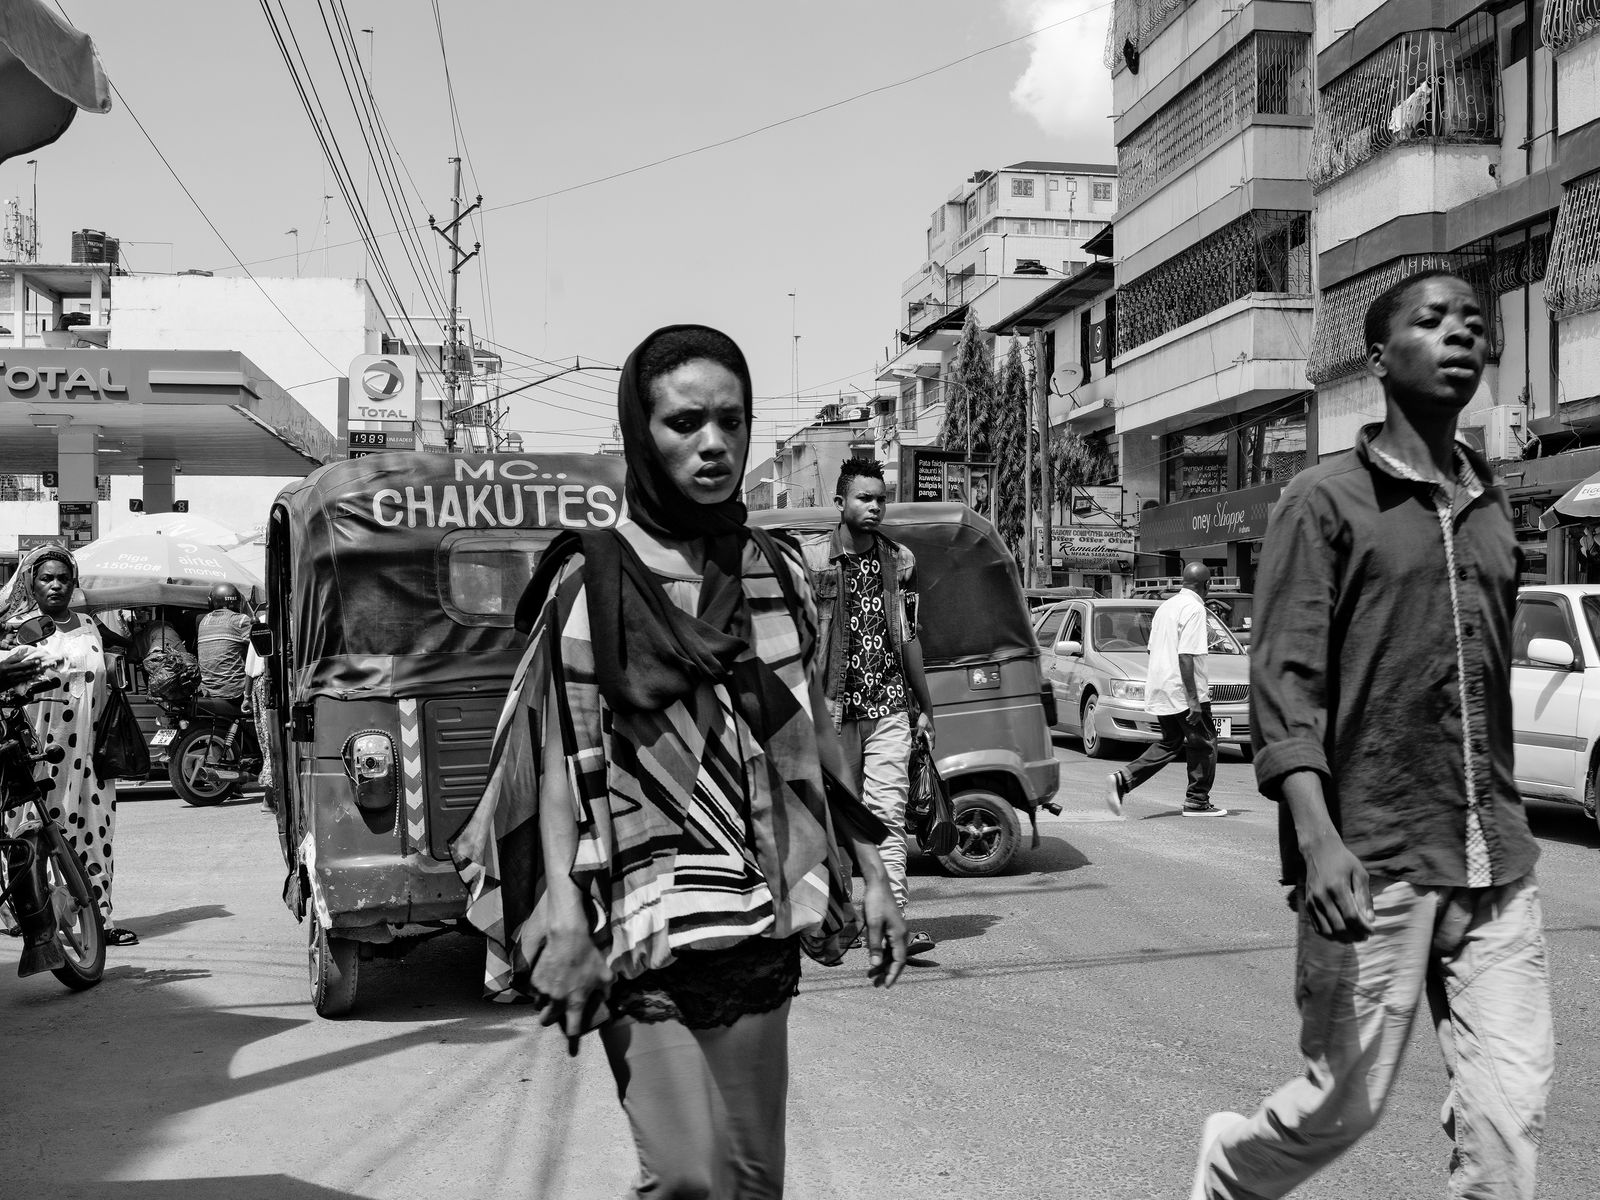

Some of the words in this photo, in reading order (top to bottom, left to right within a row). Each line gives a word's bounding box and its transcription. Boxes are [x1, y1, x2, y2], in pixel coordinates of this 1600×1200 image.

[0, 361, 127, 391] OTAL
[358, 406, 408, 418] TOTAL
[355, 434, 384, 444] 1989
[919, 459, 931, 467] Pata
[46, 473, 55, 486] 3
[919, 474, 941, 482] kuweka
[919, 482, 938, 490] kulipia
[918, 490, 938, 498] pango.
[132, 500, 140, 511] 7
[178, 501, 185, 512] 8
[372, 484, 617, 528] CHAKUTES
[1213, 501, 1245, 534] Shoppe
[118, 553, 149, 564] Piga
[178, 555, 224, 569] airtel
[183, 567, 227, 579] money
